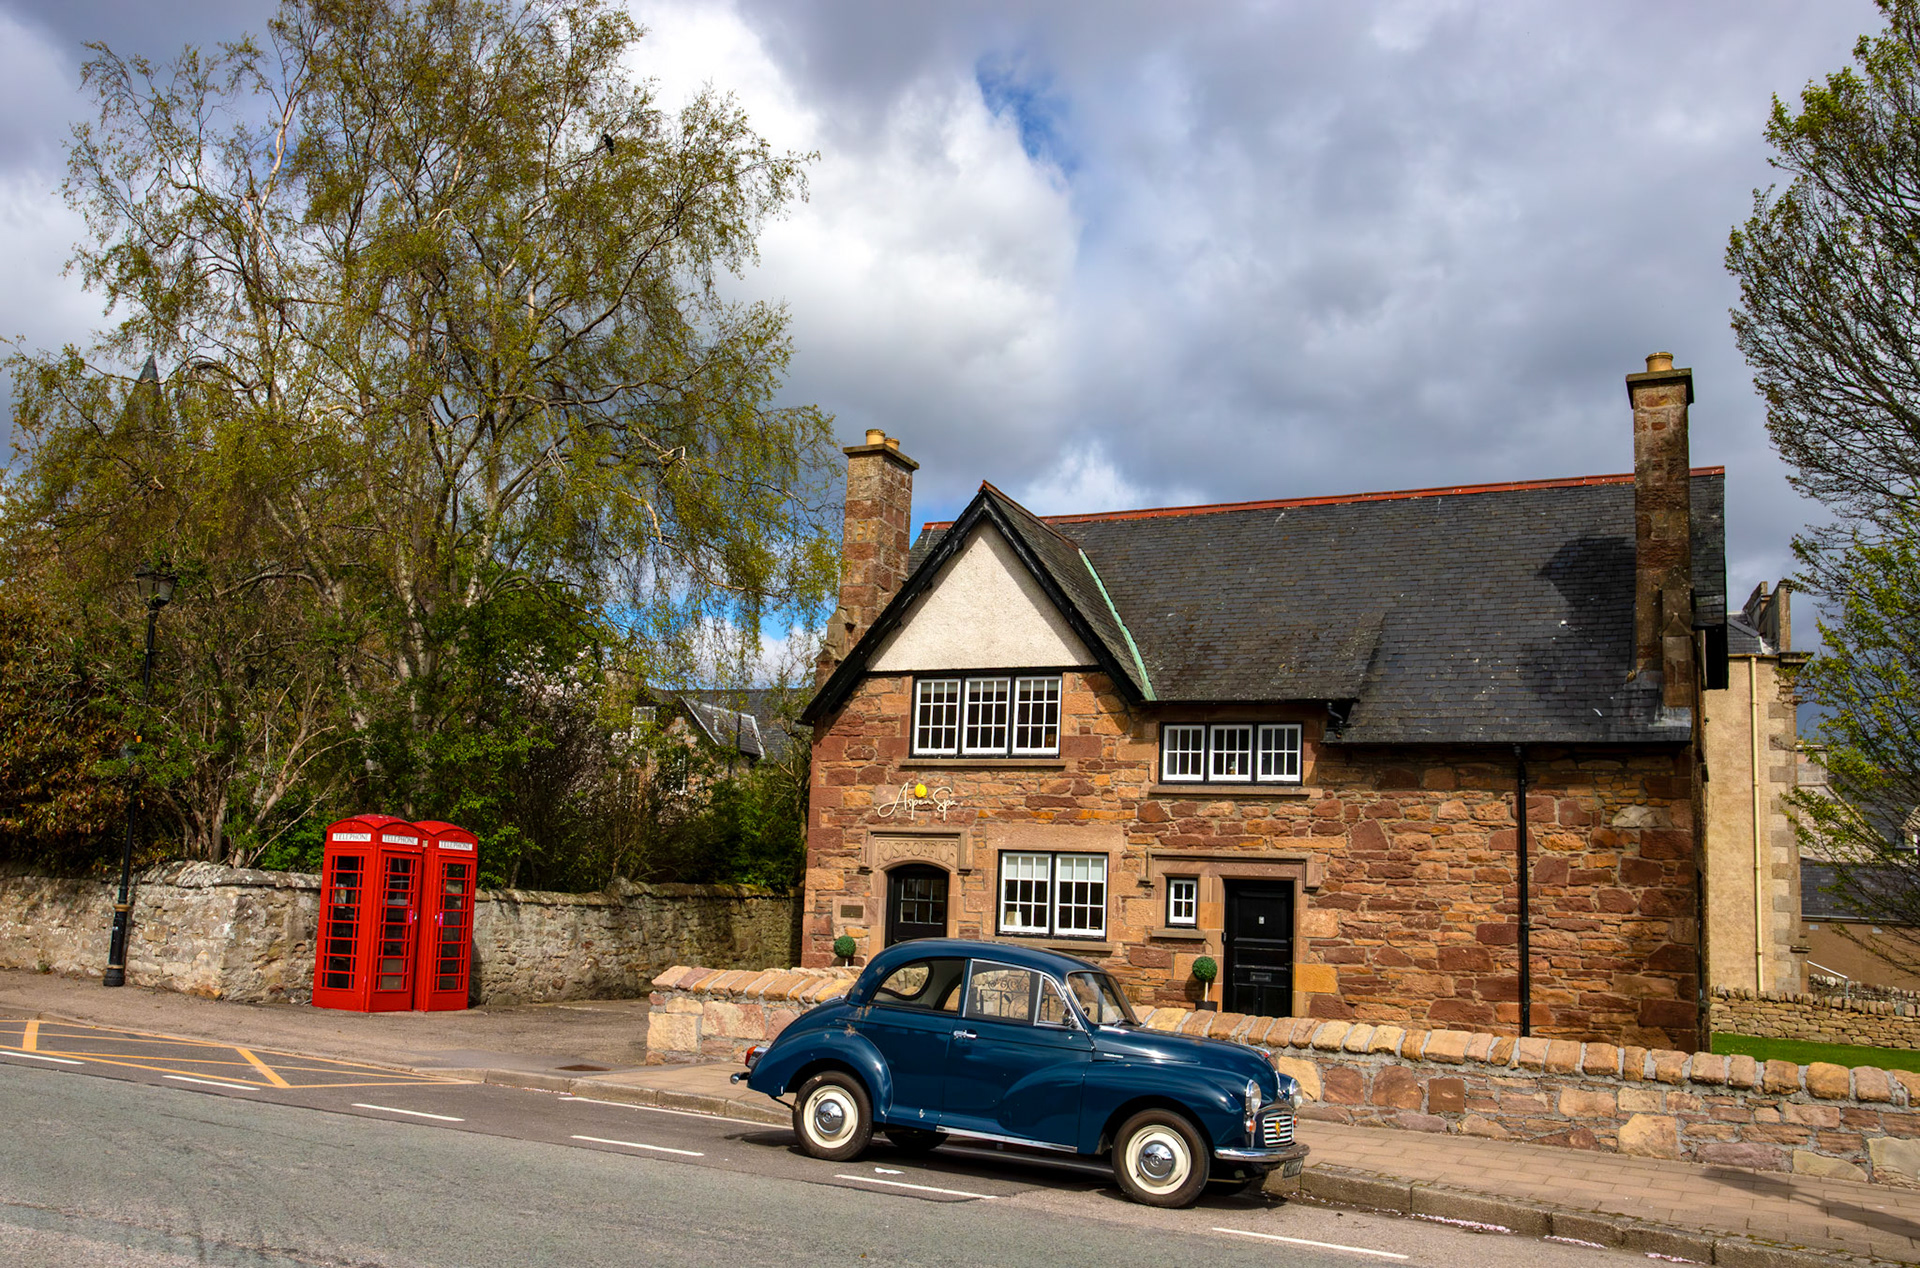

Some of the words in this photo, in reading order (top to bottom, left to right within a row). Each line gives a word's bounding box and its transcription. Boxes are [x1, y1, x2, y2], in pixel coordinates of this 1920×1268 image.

[878, 782, 934, 820] Aspen
[933, 787, 958, 821] Spa
[334, 833, 370, 841] TELEPHONE
[383, 835, 416, 845] TELEPHONE
[440, 840, 471, 850] TELEPHONE
